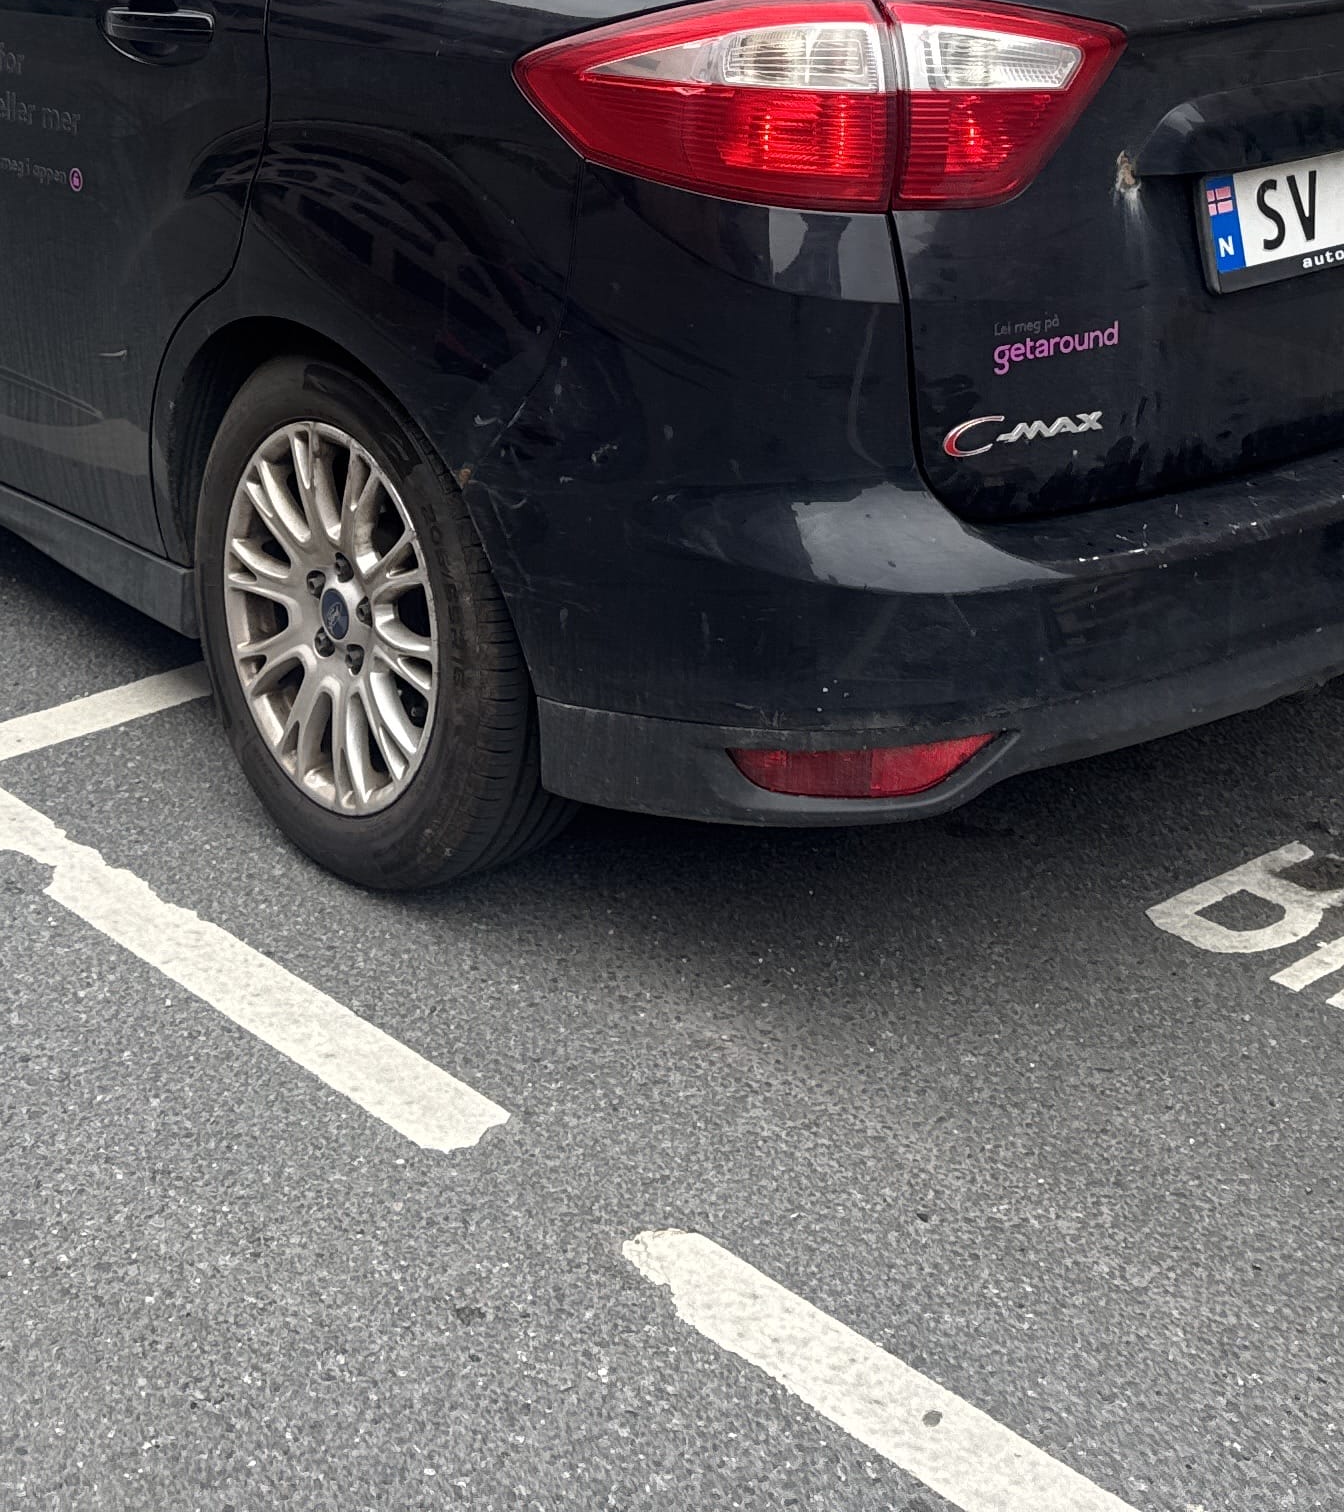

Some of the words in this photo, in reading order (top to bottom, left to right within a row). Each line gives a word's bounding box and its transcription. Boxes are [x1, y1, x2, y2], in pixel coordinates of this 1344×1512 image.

[42, 107, 81, 137] mer
[1256, 169, 1318, 252] SV
[1218, 237, 1235, 258] N
[993, 320, 1119, 376] getaround
